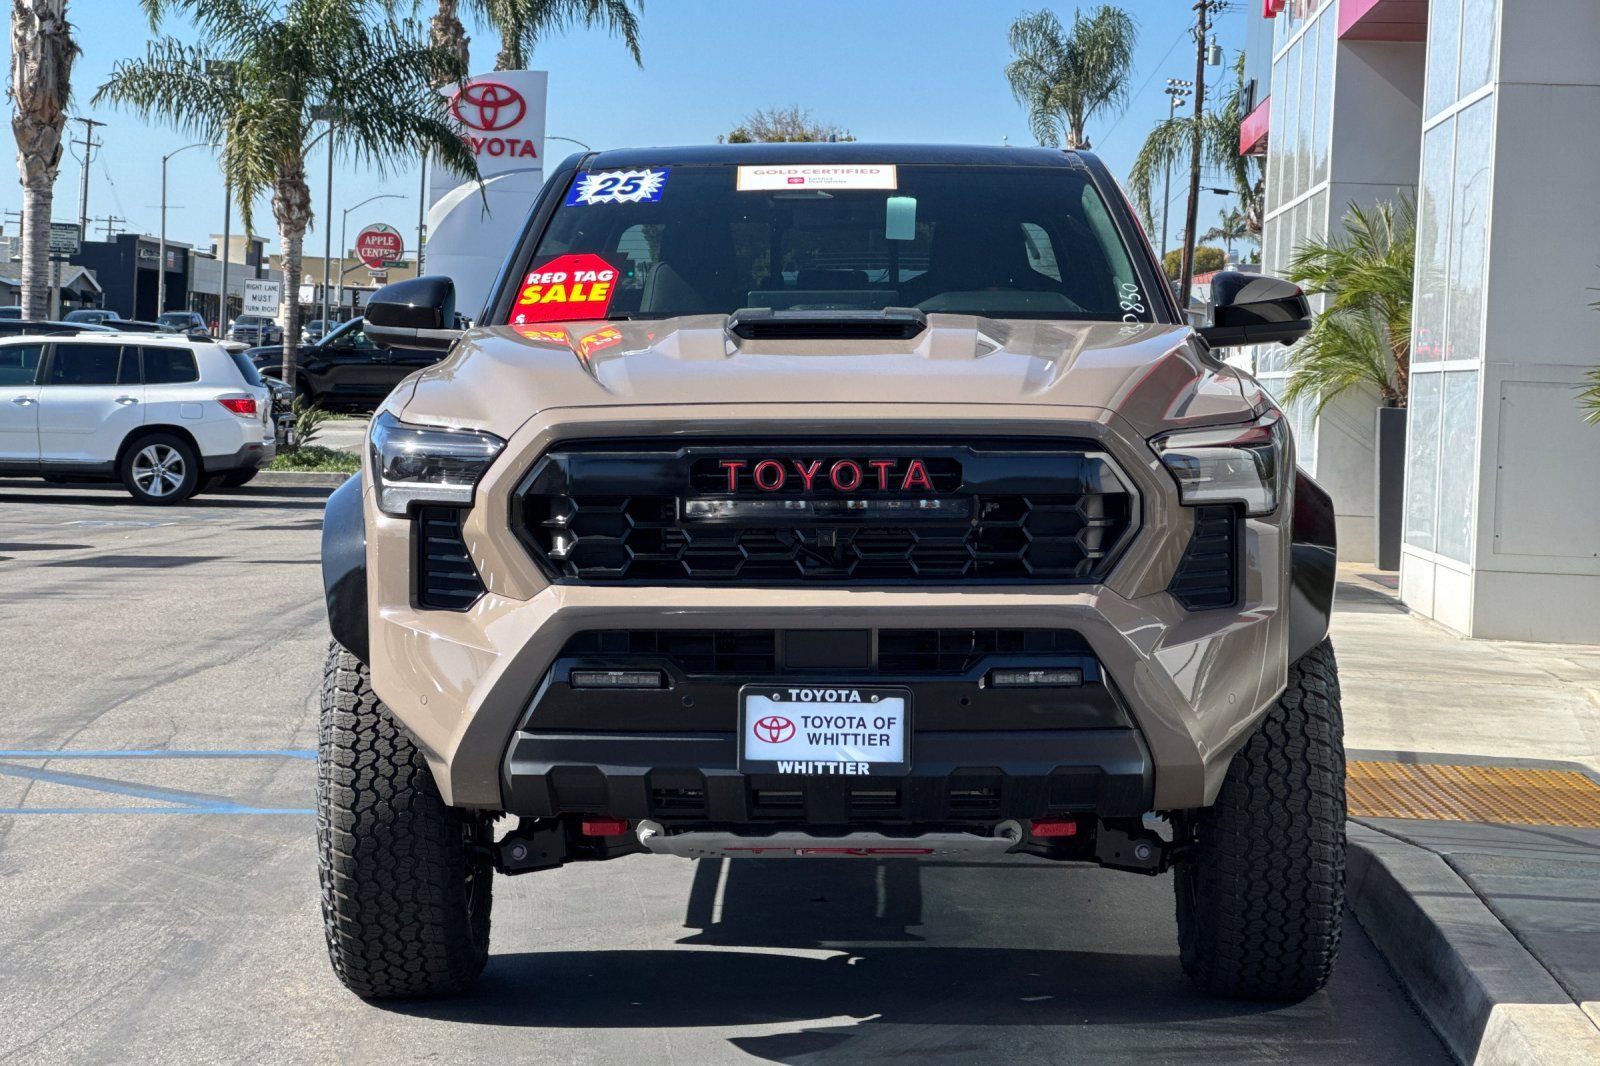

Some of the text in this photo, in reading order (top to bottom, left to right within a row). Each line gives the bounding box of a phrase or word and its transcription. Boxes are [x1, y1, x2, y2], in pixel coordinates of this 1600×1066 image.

[463, 136, 537, 158] YOTA
[591, 176, 646, 197] 25
[364, 235, 395, 246] APPLE
[361, 247, 397, 258] CENTER
[527, 269, 614, 284] RED TAG
[251, 294, 272, 303] MUST
[519, 282, 610, 305] SALE
[719, 459, 937, 493] TOYOTA
[788, 689, 862, 703] TOYOTA
[801, 715, 897, 730] TOYOTA OF
[807, 732, 890, 746] WHITTIER
[777, 761, 870, 775] WHITTIER
